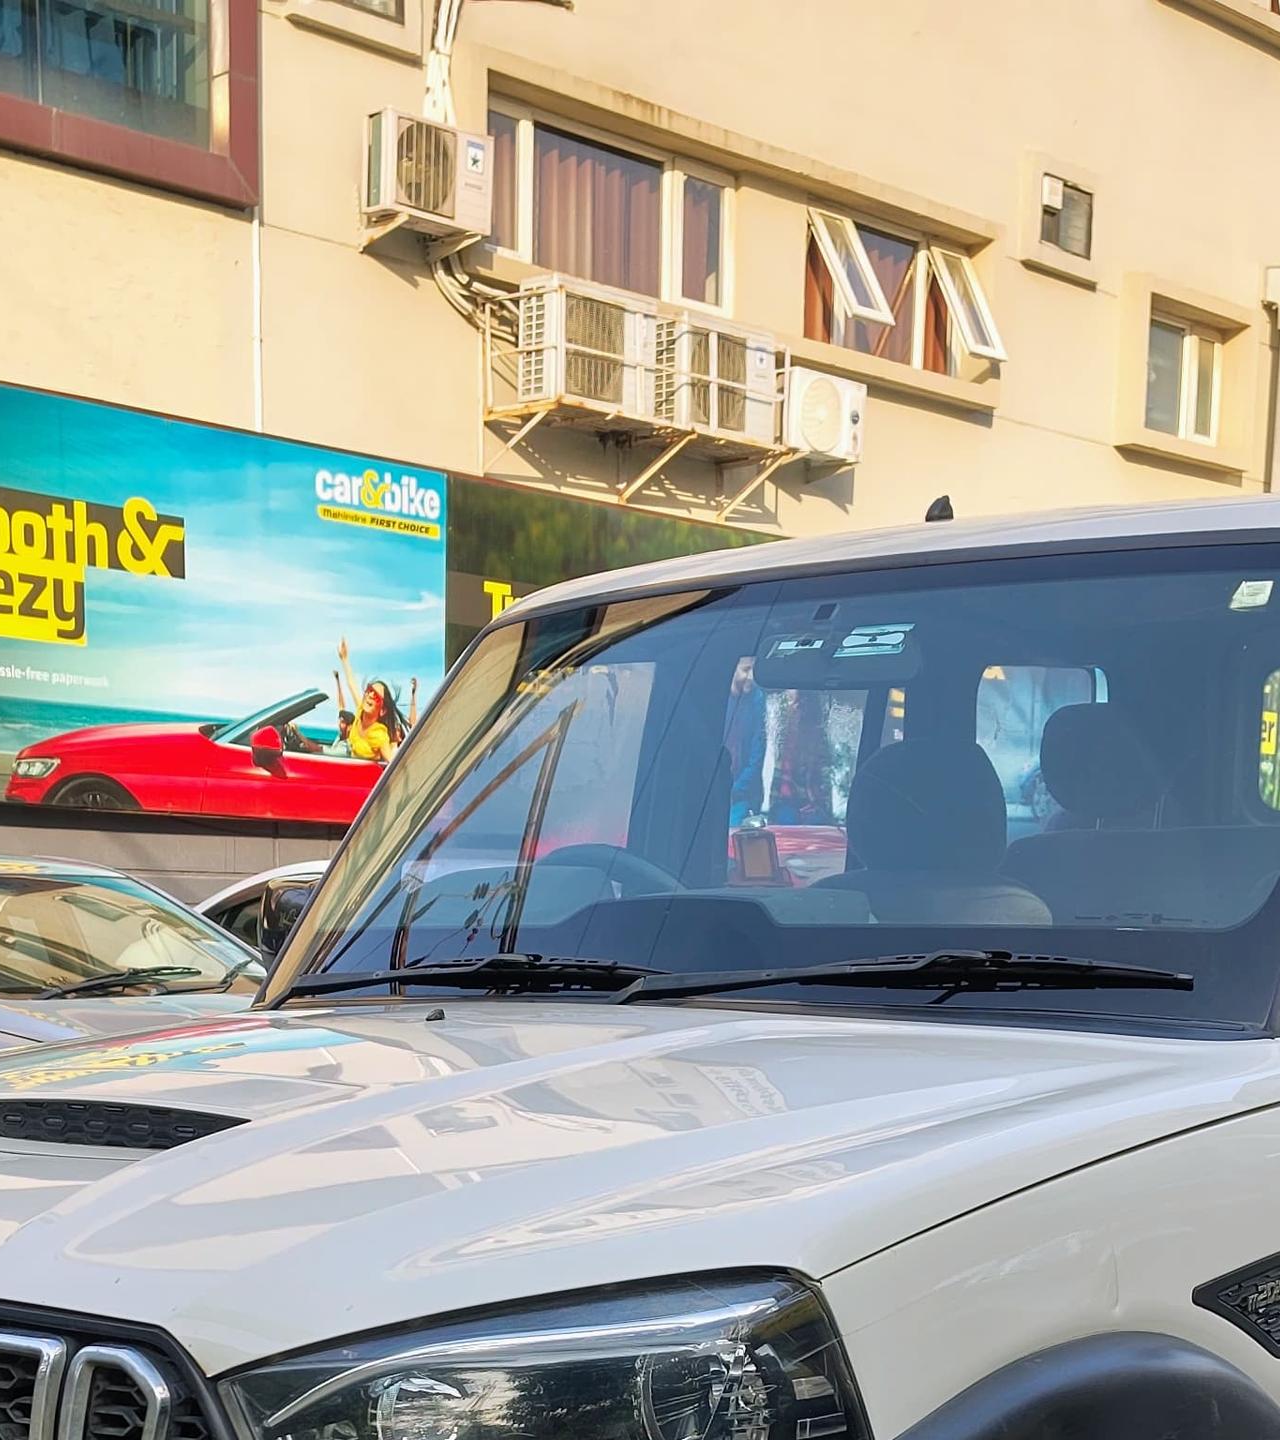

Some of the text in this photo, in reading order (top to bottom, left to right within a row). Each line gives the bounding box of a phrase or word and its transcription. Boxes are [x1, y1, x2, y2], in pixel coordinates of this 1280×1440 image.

[315, 469, 440, 519] car&bike
[117, 497, 185, 577] &
[370, 517, 396, 530] FIRST
[398, 521, 431, 534] CHOICE
